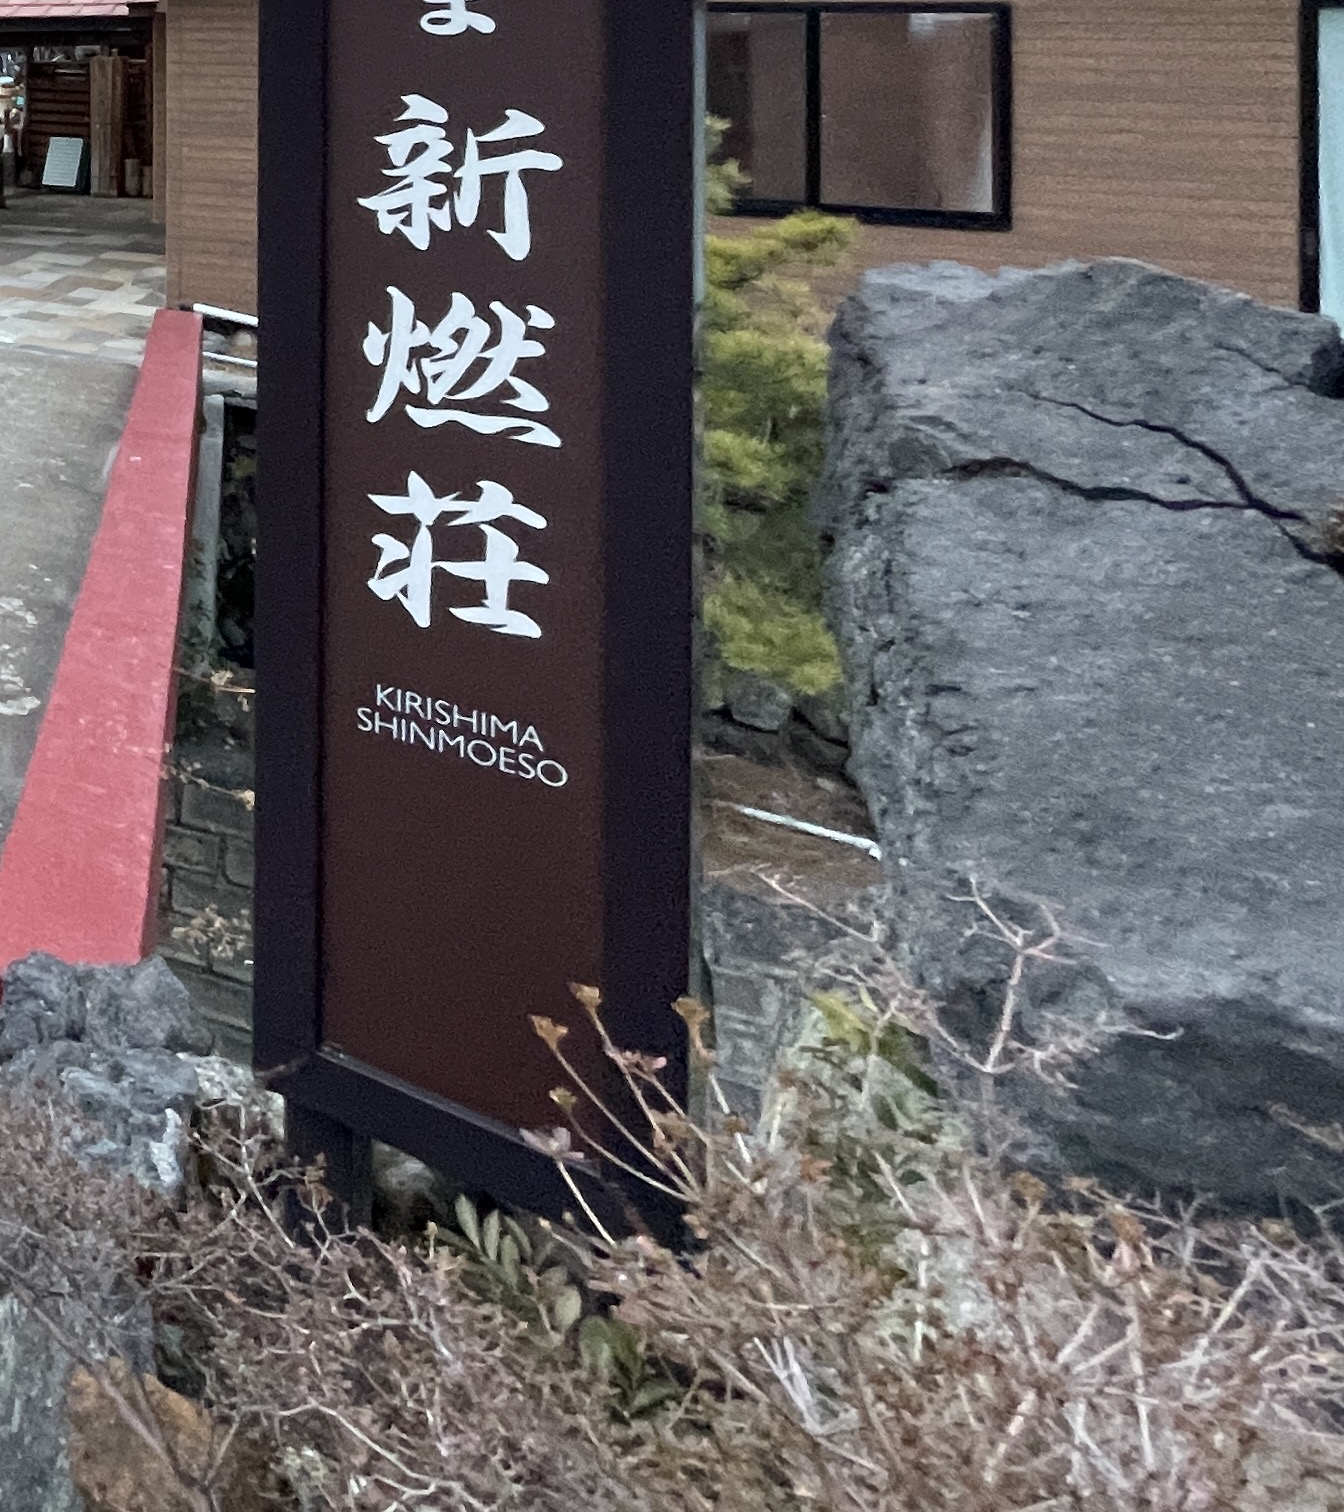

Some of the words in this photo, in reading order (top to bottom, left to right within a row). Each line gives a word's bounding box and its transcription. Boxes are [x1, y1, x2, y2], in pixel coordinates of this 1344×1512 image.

[357, 94, 563, 638] 新燃荘
[357, 707, 568, 787] SHINMOESO
[377, 684, 544, 752] KIRISHIMA
